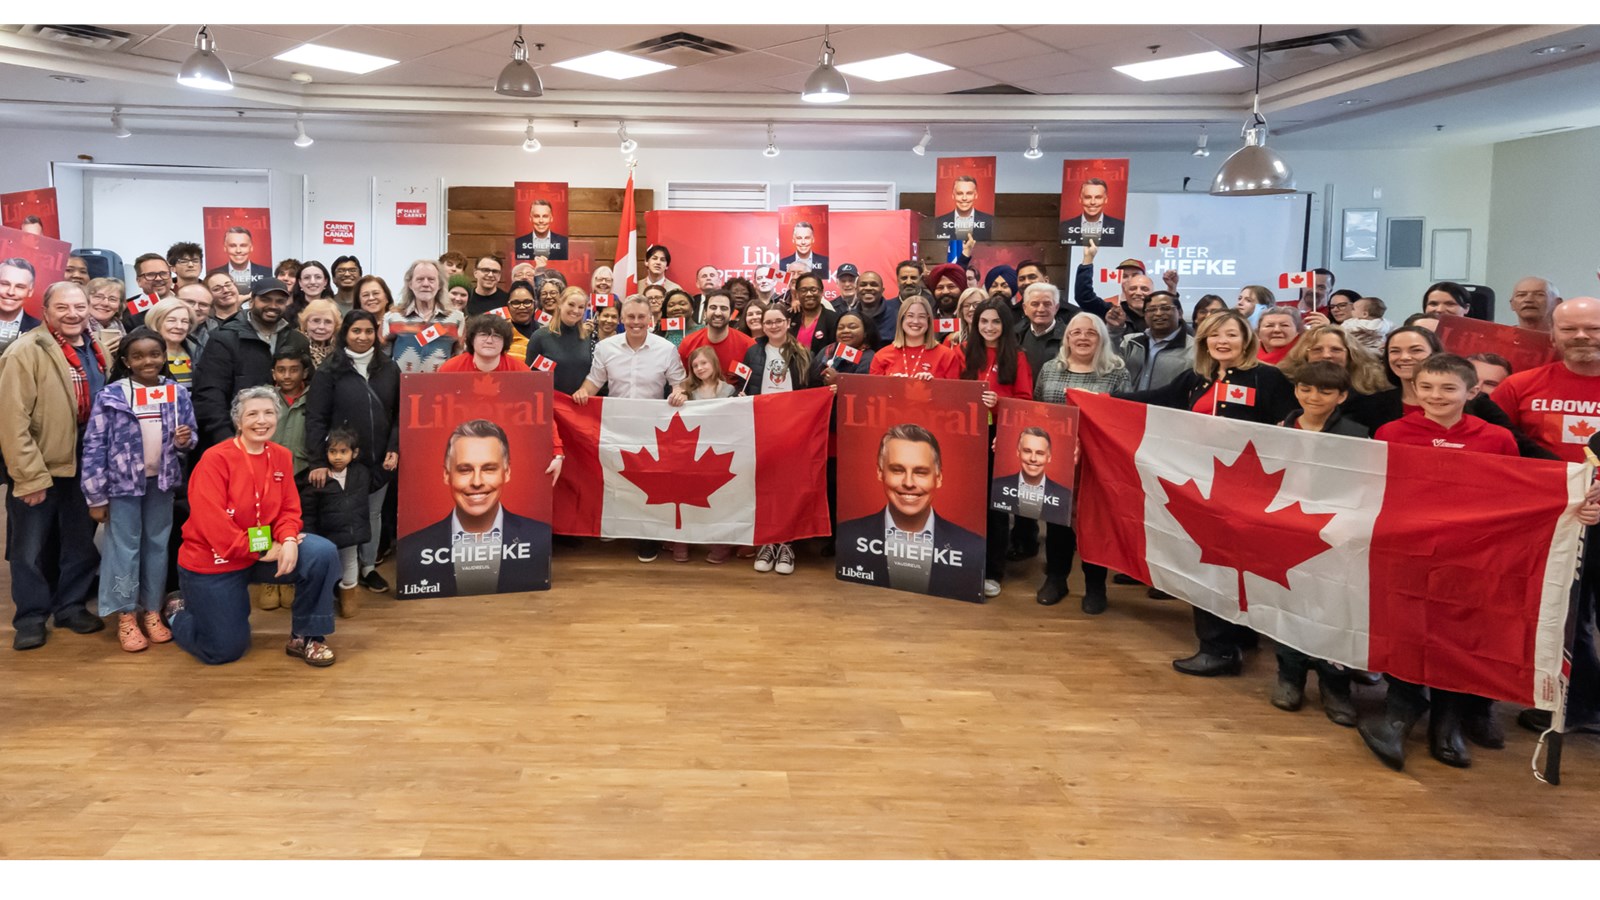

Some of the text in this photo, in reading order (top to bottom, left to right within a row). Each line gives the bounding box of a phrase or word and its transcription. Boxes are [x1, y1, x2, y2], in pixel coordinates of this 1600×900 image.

[325, 223, 354, 231] CARNEY
[942, 221, 985, 229] SCHIEFKE
[1067, 226, 1116, 235] SCHIEFKE
[521, 242, 561, 250] SCHIEFKE
[1161, 246, 1209, 258] ETER
[1002, 486, 1060, 506] SCHIEFKE
[452, 531, 502, 545] PETER
[884, 528, 934, 545] PETER
[420, 542, 531, 565] SCHIEFKE
[856, 537, 963, 567] SCHIEFKE
